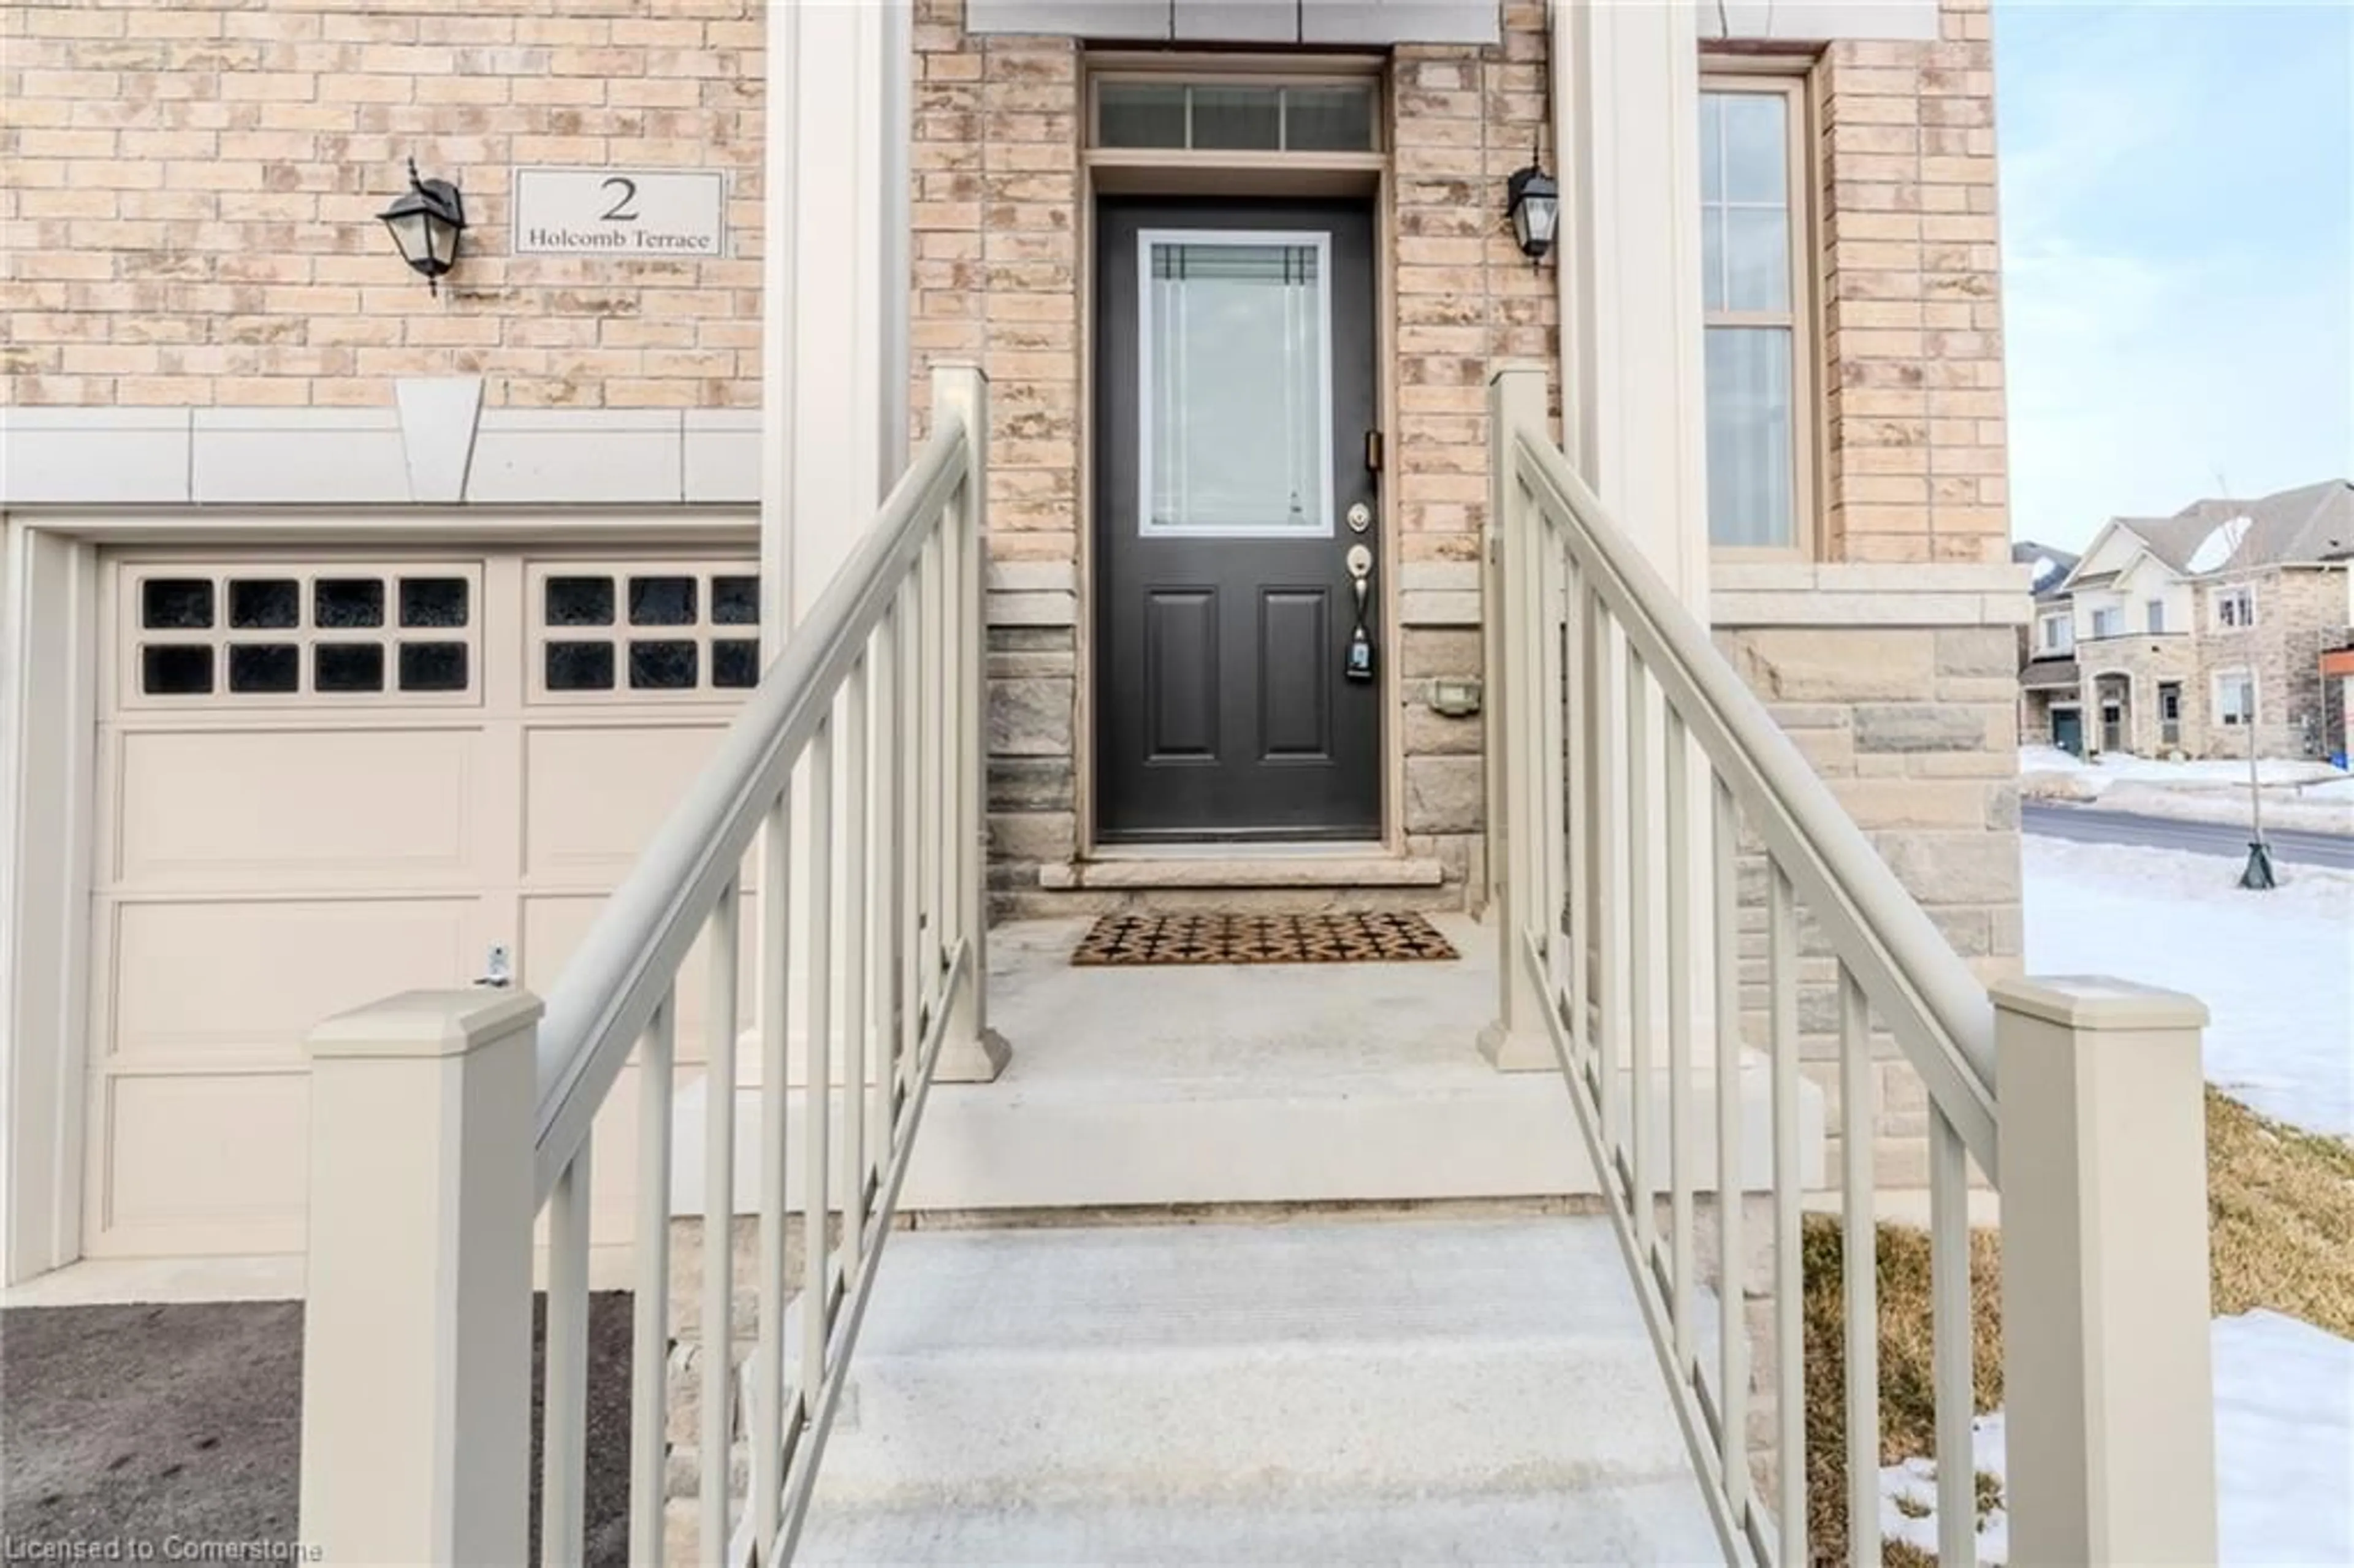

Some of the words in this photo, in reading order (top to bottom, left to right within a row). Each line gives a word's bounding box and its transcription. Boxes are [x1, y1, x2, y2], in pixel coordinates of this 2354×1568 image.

[600, 177, 639, 221] 2
[530, 229, 626, 246] Holcomb
[634, 230, 710, 248] Terrace
